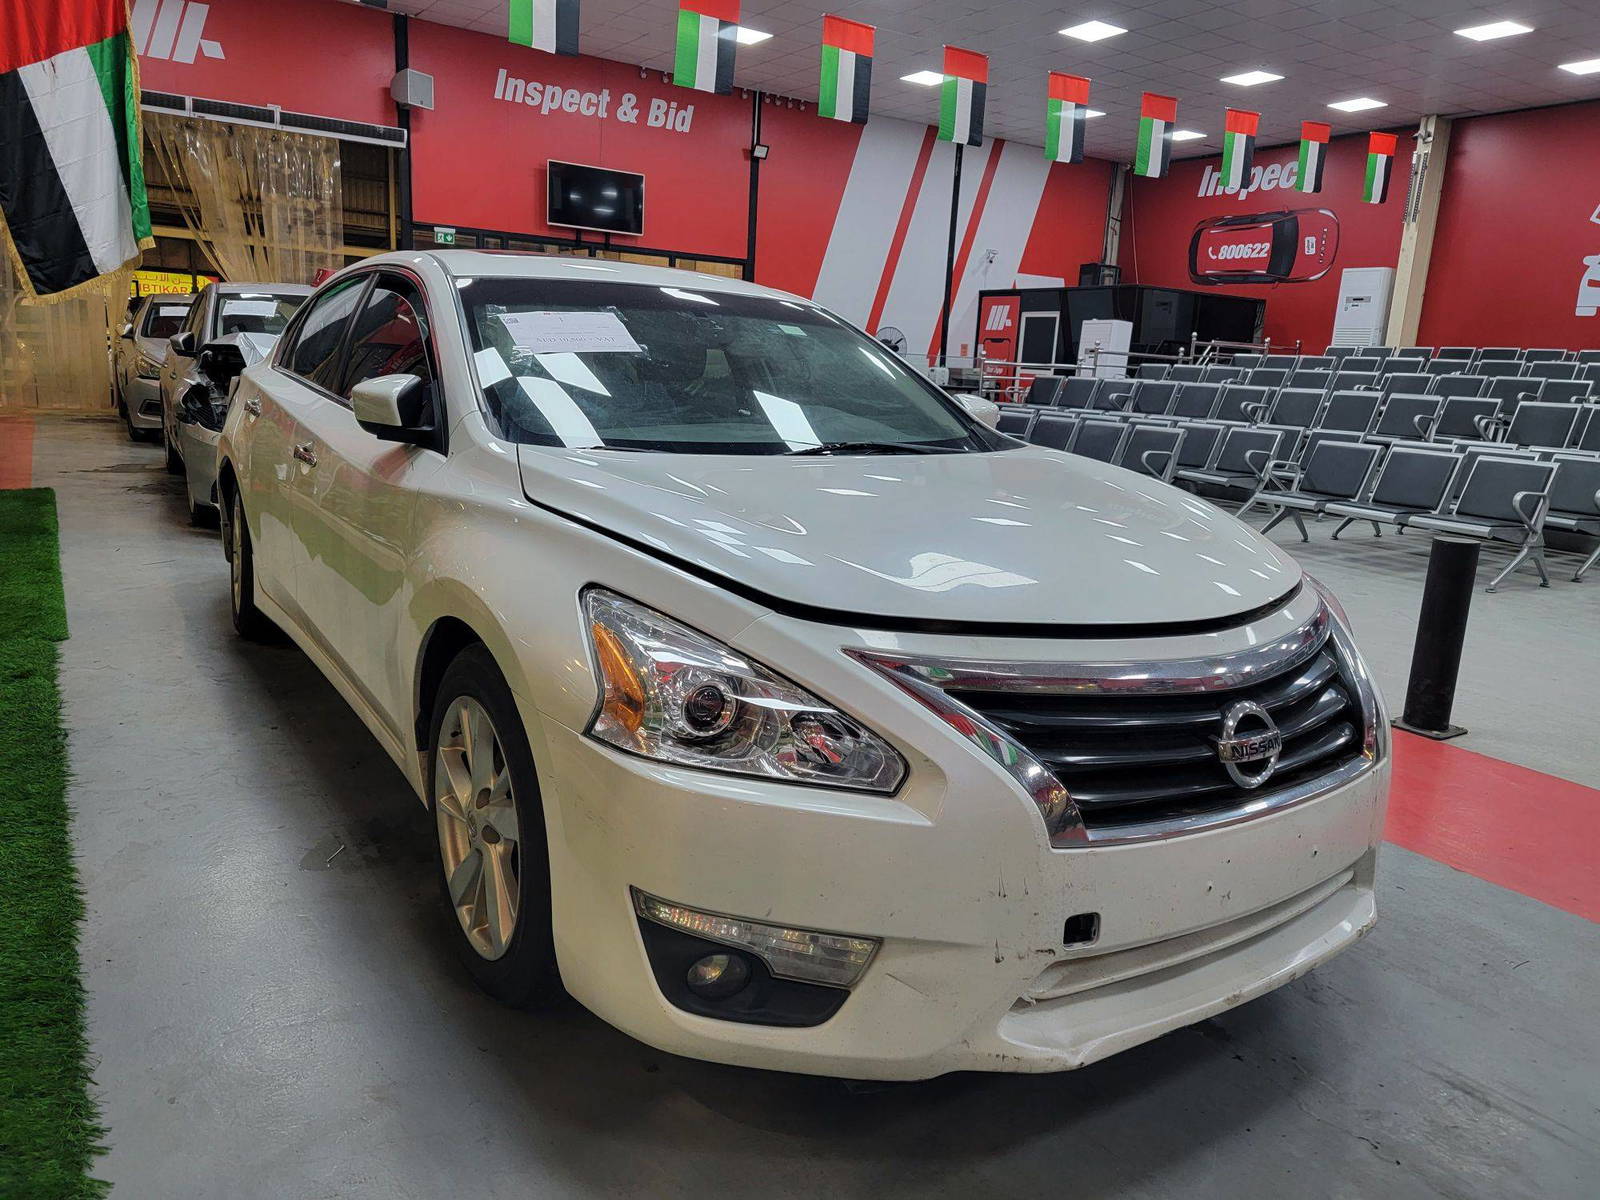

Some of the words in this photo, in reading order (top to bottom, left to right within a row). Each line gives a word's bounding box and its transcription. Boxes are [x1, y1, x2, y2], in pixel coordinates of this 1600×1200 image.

[494, 68, 610, 118] Inspect
[616, 93, 640, 124] &
[647, 98, 694, 133] Bid
[1218, 243, 1270, 260] 800622
[1231, 736, 1281, 760] NISSAN
